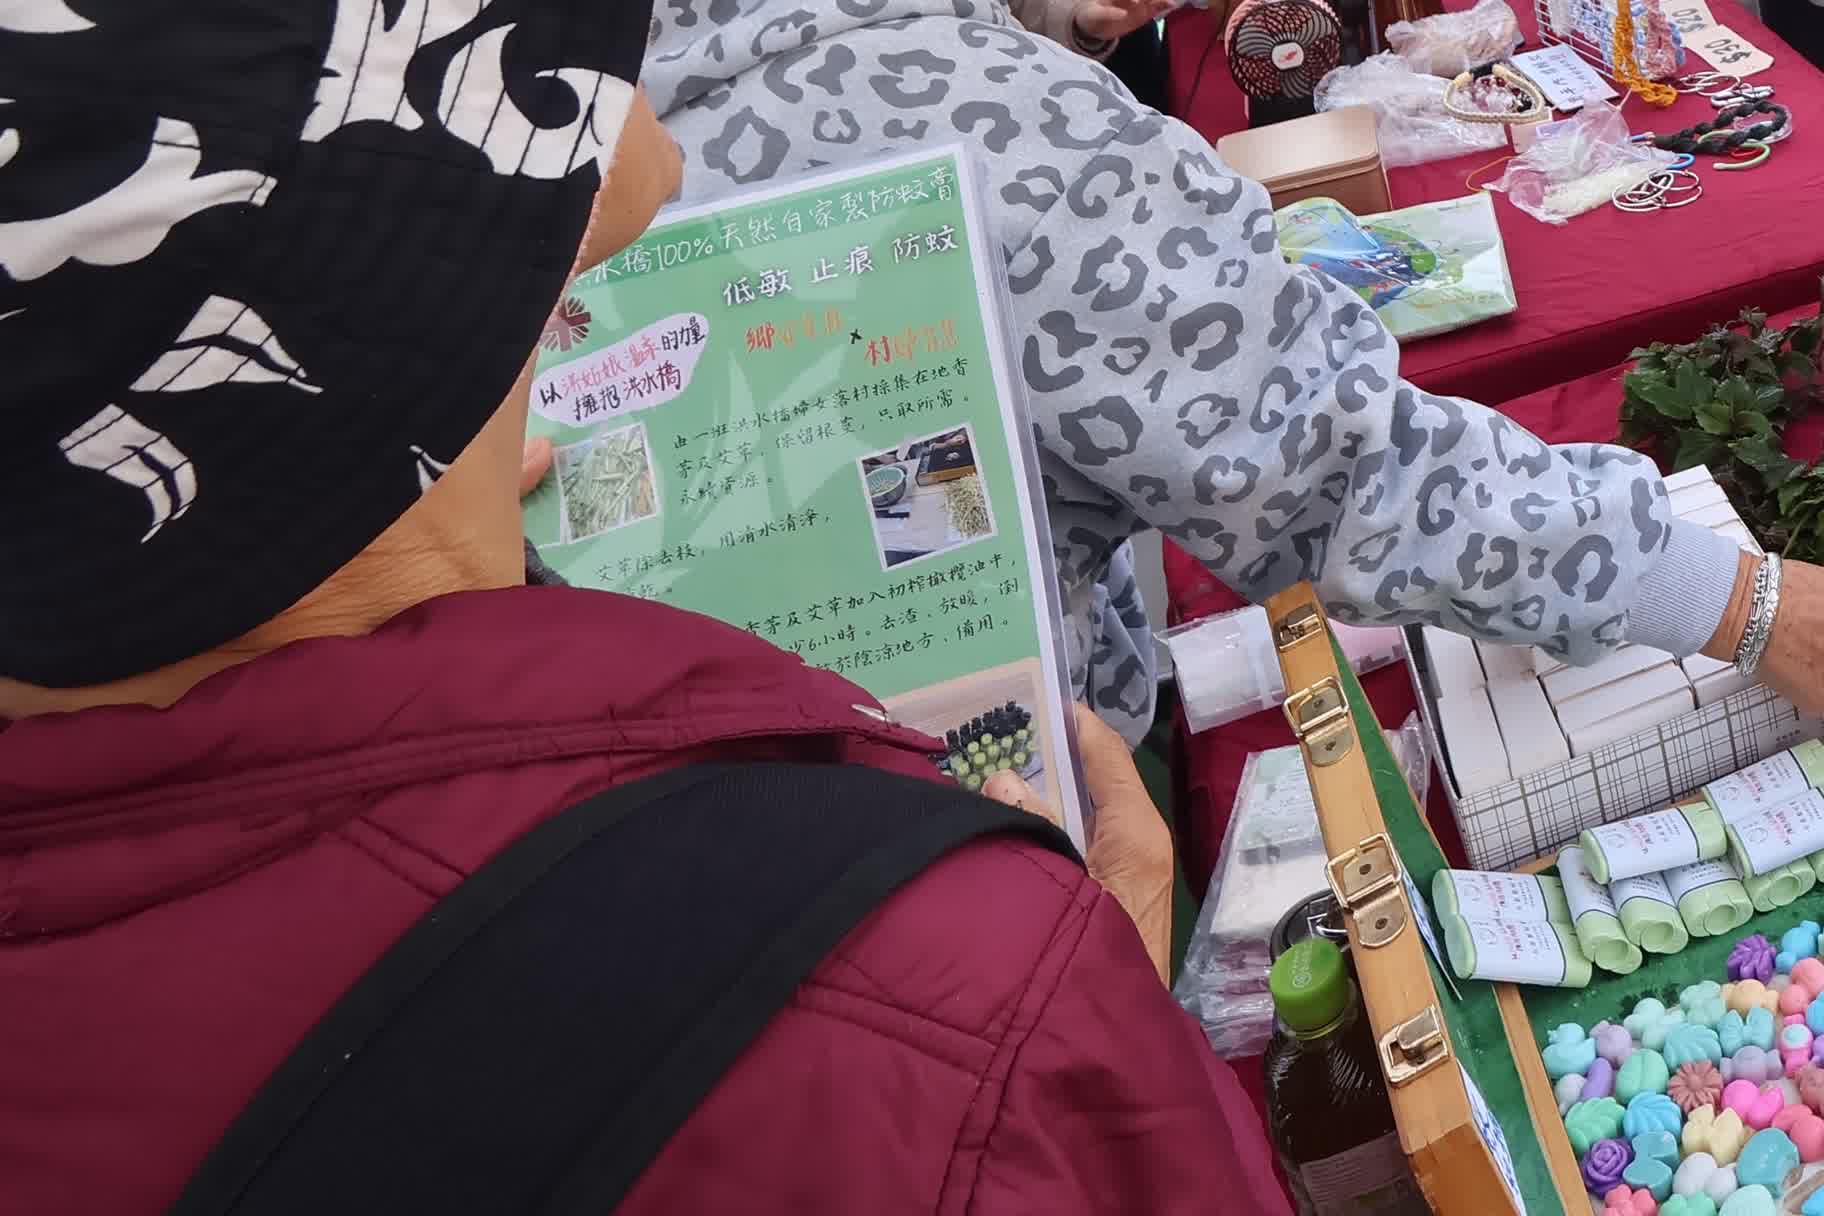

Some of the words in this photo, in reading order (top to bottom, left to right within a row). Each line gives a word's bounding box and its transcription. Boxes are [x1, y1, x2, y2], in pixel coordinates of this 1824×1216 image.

[574, 165, 955, 287] 水橋100%天然自家製防蚊膏
[722, 268, 793, 307] 低敏
[807, 244, 874, 285] 止痕
[890, 224, 959, 265] 防蚊
